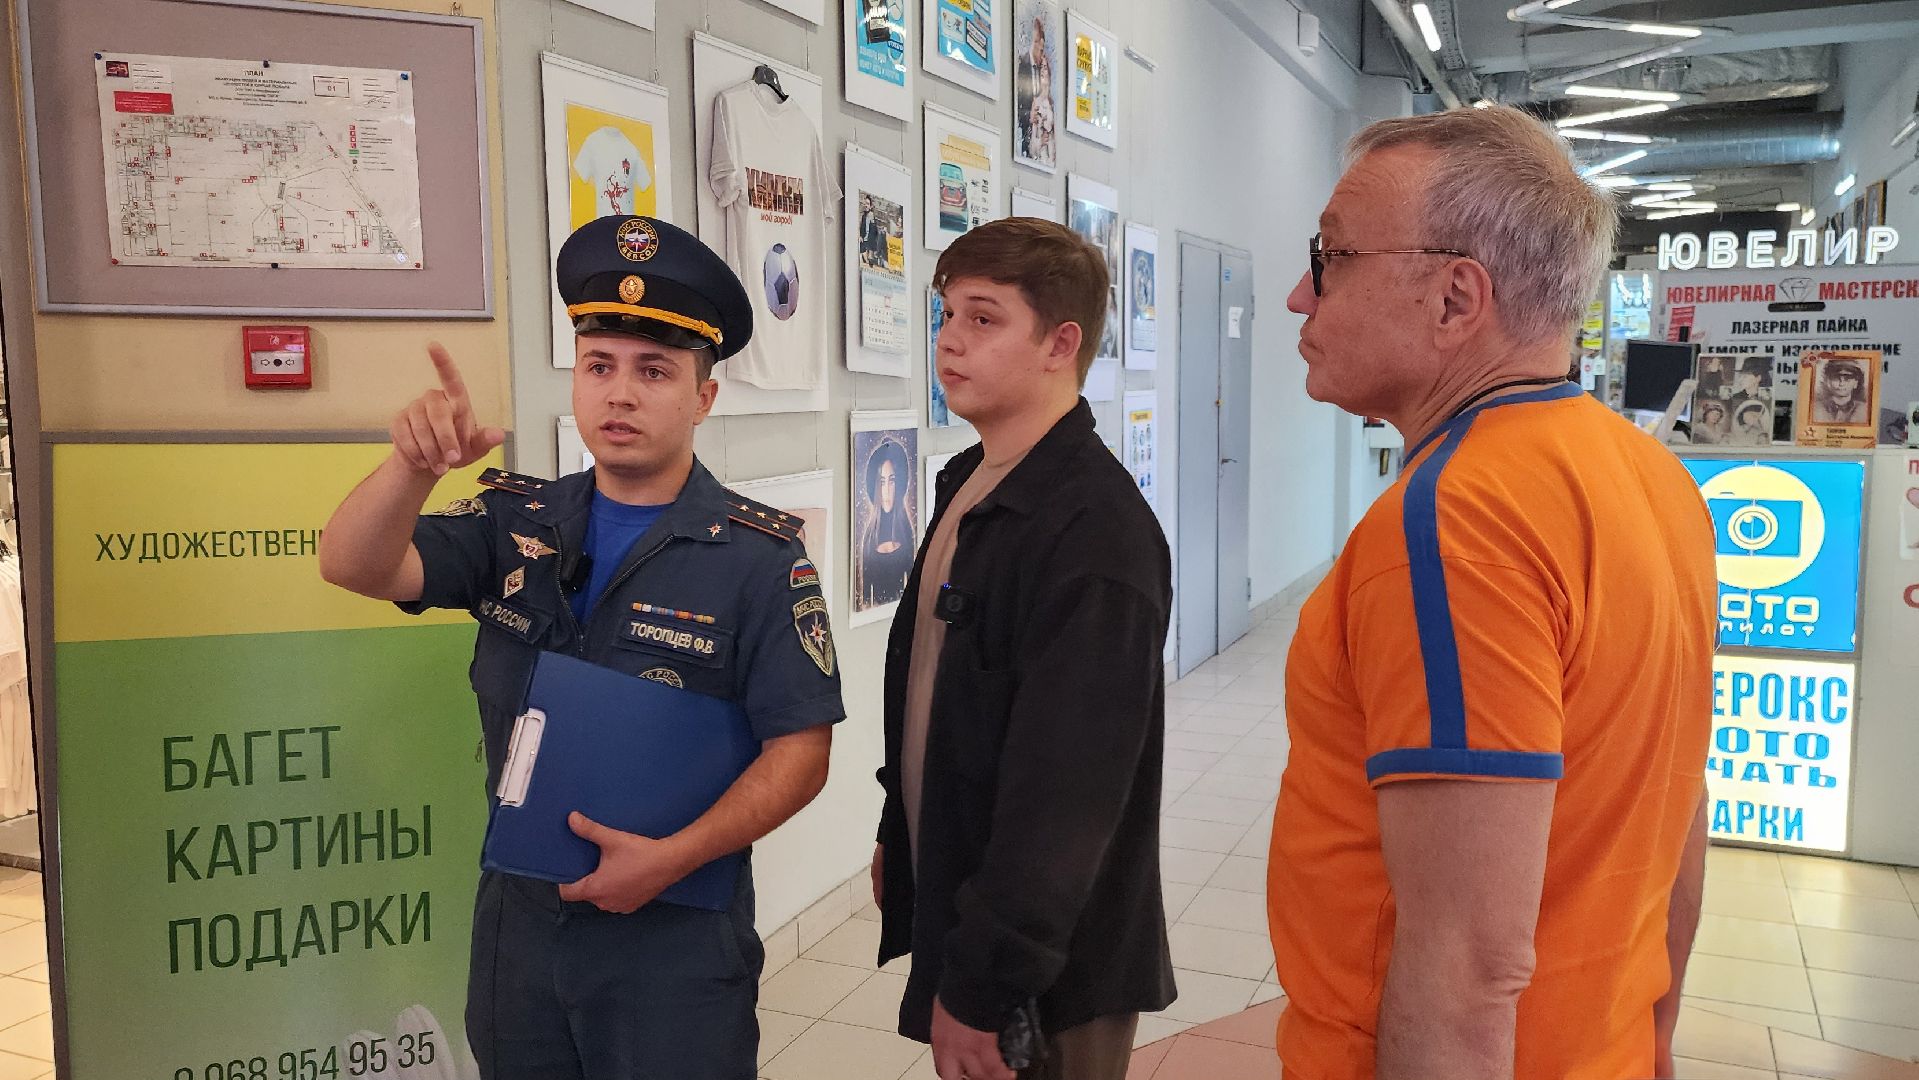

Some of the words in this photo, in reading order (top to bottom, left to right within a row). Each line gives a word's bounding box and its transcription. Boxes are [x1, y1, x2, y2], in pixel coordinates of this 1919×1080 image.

[1658, 226, 1900, 271] ЮВЕЛИР
[1666, 284, 1776, 304] ЮВЕЛИРНАЯ
[1730, 319, 1810, 335] ЛАЗЕРНАЯ
[1816, 314, 1868, 334] ПАЙКА
[95, 529, 323, 564] ХУДОЖЕСТВЕН
[491, 604, 532, 634] РОССИИ
[630, 621, 693, 649] ТОРОПЦЕВ
[694, 637, 715, 654] Ф.В.
[162, 725, 342, 792] БАГЕТ
[166, 804, 433, 884] КАРТИНЫ
[168, 891, 432, 975] ПОДАРКИ
[278, 1045, 340, 1080] 954
[349, 1037, 388, 1076] 95
[397, 1031, 435, 1068] 35
